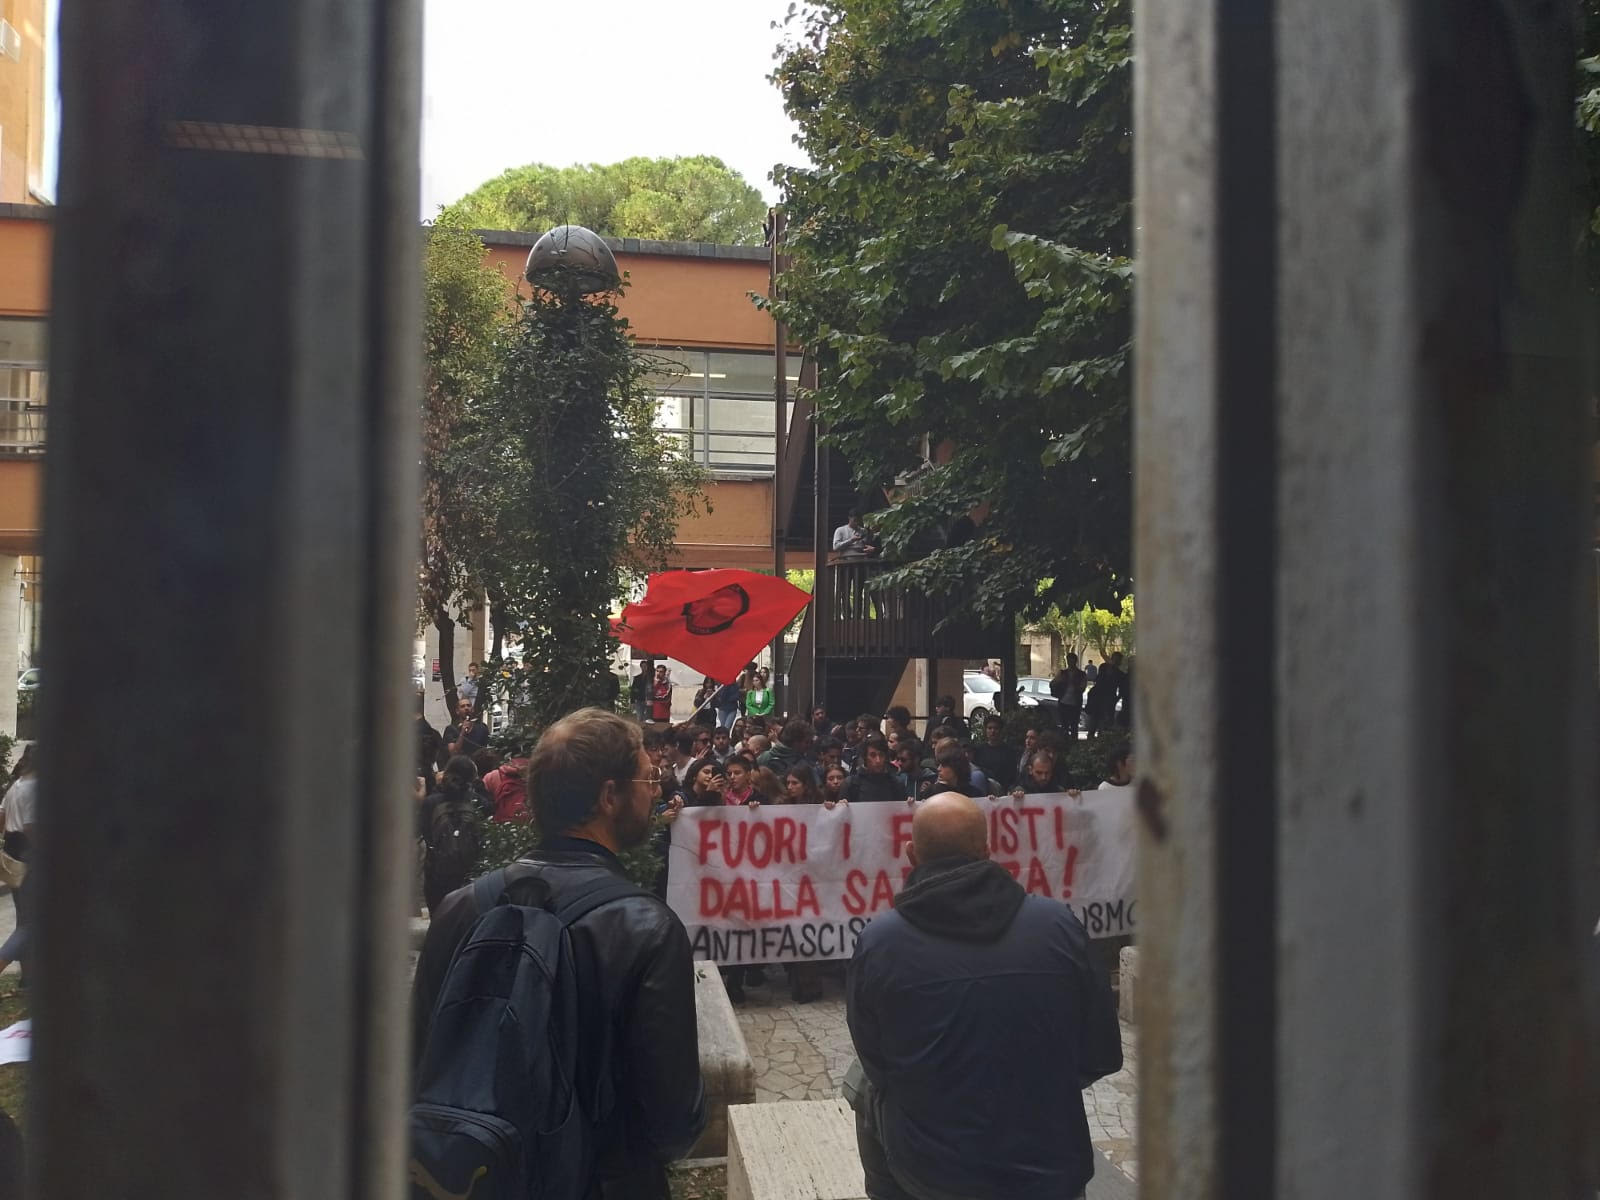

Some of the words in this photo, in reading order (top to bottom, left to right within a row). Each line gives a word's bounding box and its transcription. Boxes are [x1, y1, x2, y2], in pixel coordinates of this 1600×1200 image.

[698, 816, 808, 869] FUORI
[842, 821, 852, 860] I
[890, 805, 1065, 860] FISTI
[699, 872, 821, 921] DALLA
[692, 915, 872, 962] ANTIFASCIS
